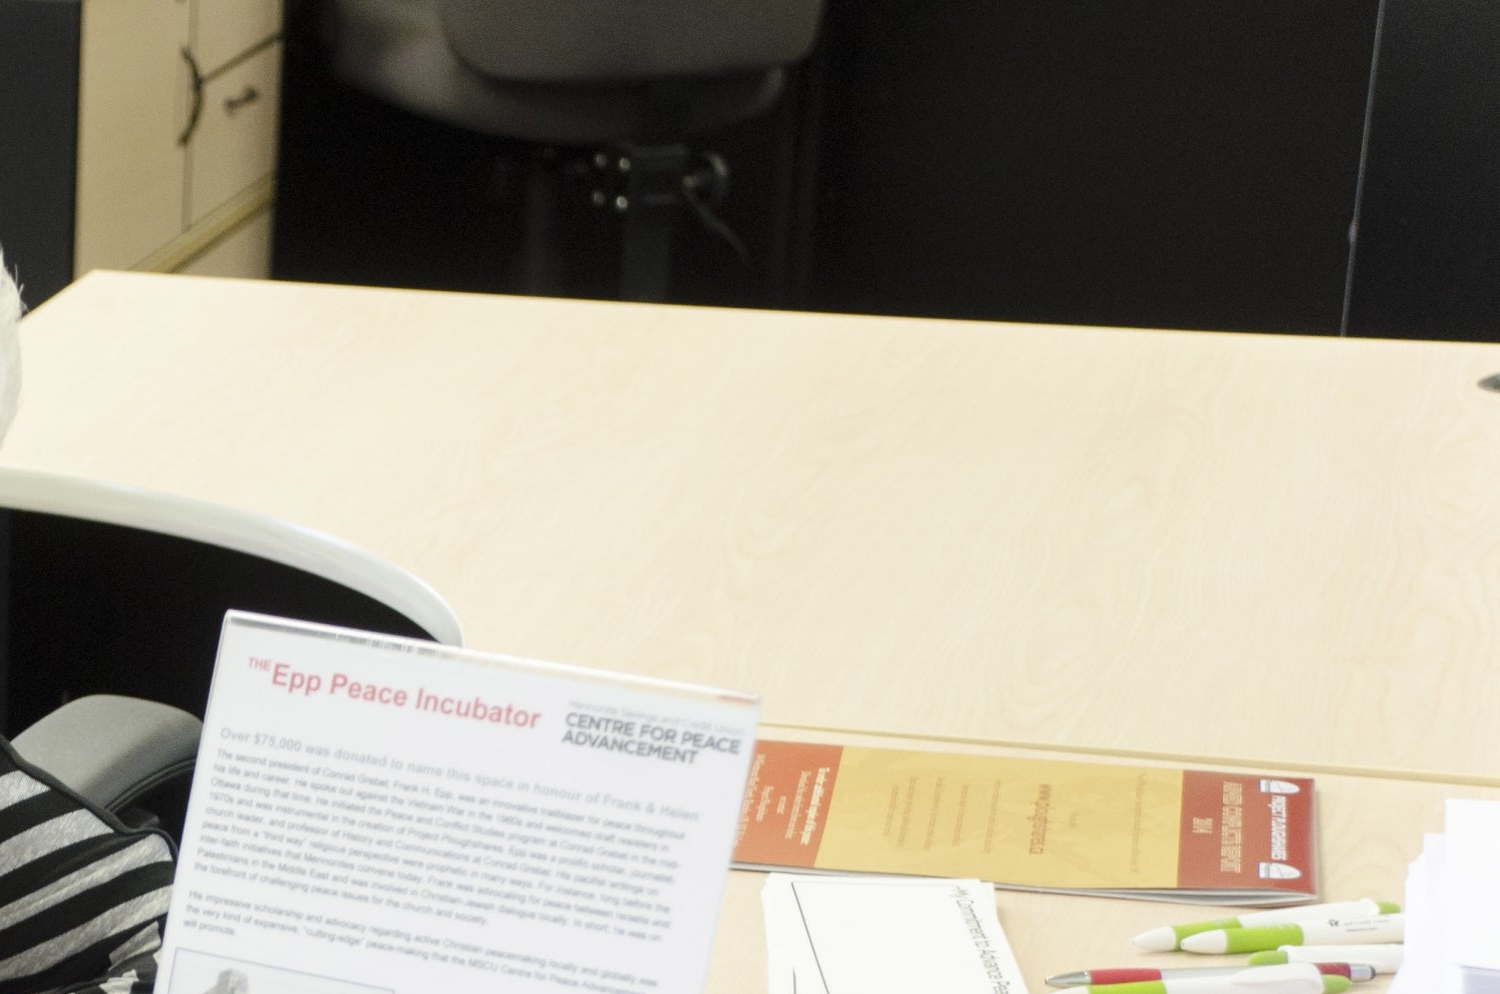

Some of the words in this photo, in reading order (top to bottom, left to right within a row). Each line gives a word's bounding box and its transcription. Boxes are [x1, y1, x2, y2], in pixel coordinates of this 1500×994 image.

[247, 656, 272, 672] THE
[270, 662, 323, 698] Epp
[329, 672, 409, 707] Peace
[415, 686, 542, 730] Incubator
[561, 728, 699, 765] ADVANCEMENT
[564, 711, 635, 737] CENTRE
[638, 723, 676, 744] FOR
[680, 730, 741, 755] PEACE
[219, 726, 250, 743] Over
[252, 732, 303, 754] $75,000
[304, 743, 331, 757] was
[333, 746, 388, 766] donated
[389, 756, 404, 769] to
[406, 761, 444, 776] name
[446, 766, 472, 781] this
[473, 773, 514, 791] space
[516, 778, 531, 791] in
[532, 781, 583, 800] honour
[584, 790, 600, 804] of
[601, 793, 642, 811] Frank
[644, 800, 657, 813] &
[658, 803, 700, 821] Helen
[949, 888, 969, 899] My
[956, 900, 988, 939] Commitment
[975, 939, 990, 948] to
[980, 949, 1003, 980] Advance
